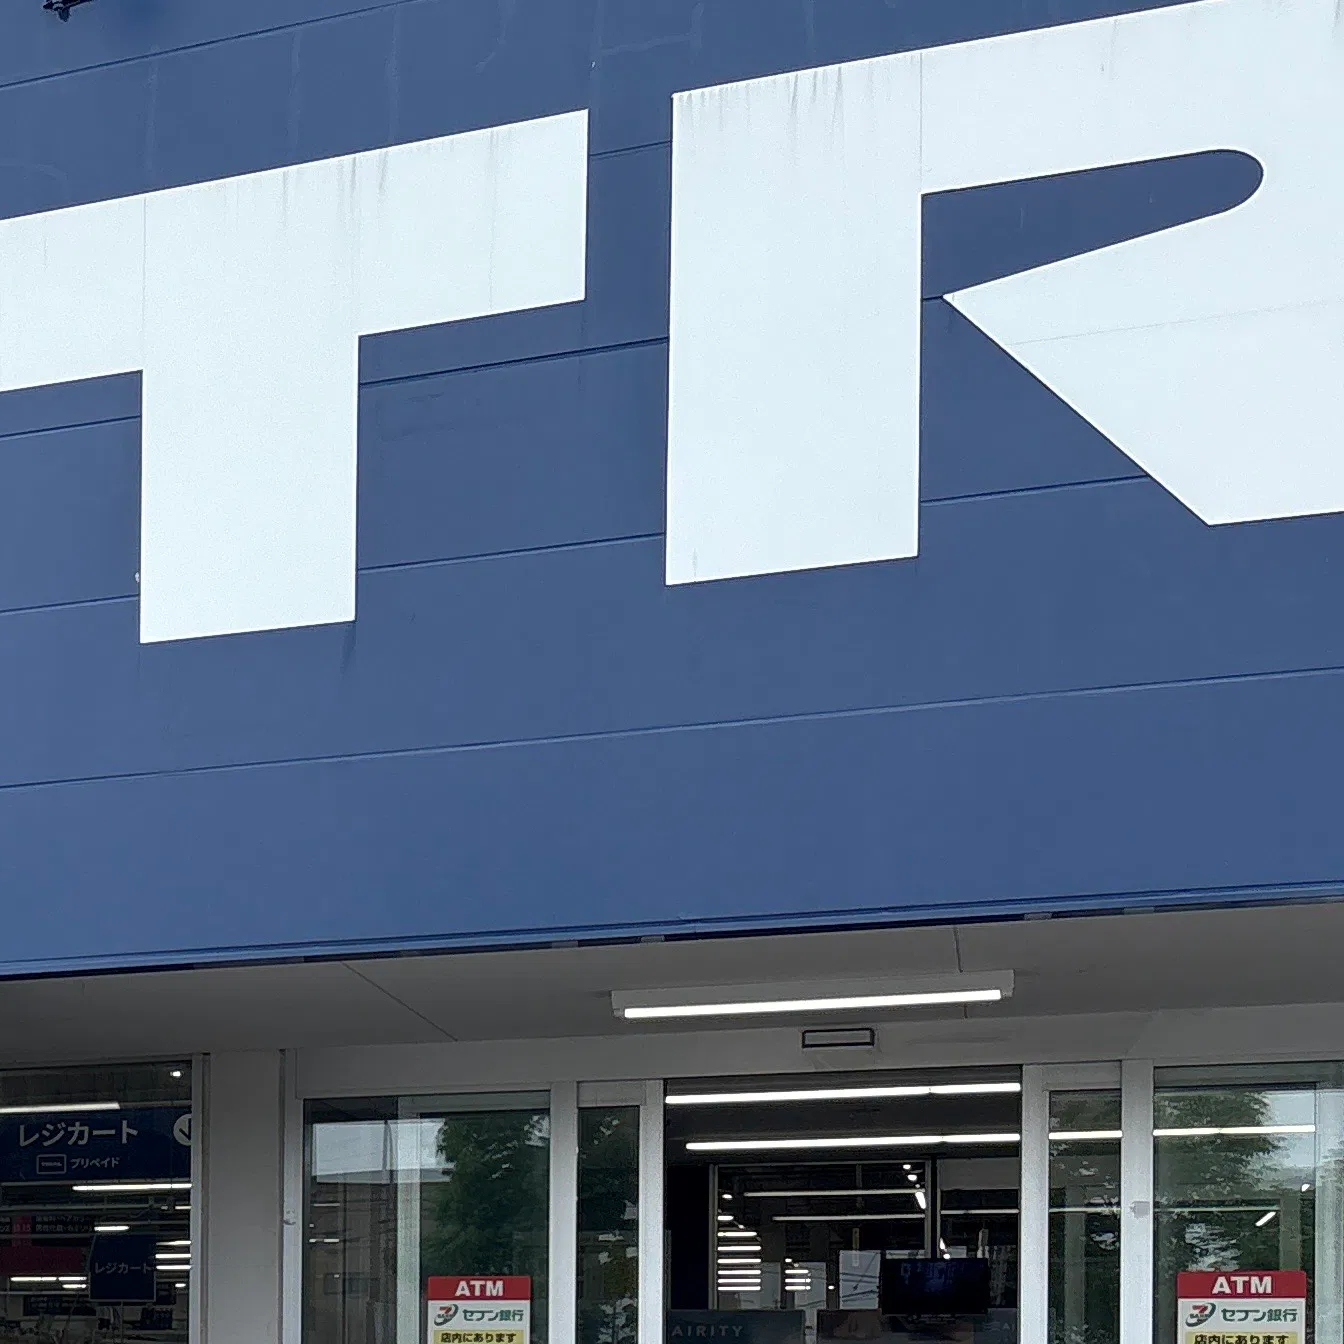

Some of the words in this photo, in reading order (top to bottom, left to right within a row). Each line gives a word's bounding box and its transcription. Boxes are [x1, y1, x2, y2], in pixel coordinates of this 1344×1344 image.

[18, 1118, 139, 1148] レジカート
[71, 1156, 121, 1169] プリペイド
[94, 1261, 154, 1275] レジカート
[454, 1280, 504, 1297] ATM
[1211, 1275, 1272, 1295] ATM
[462, 1309, 524, 1322] セブン銀行
[1221, 1307, 1298, 1323] セブン銀行
[440, 1332, 516, 1344] 店内にあります
[670, 1324, 744, 1338] AIRITY
